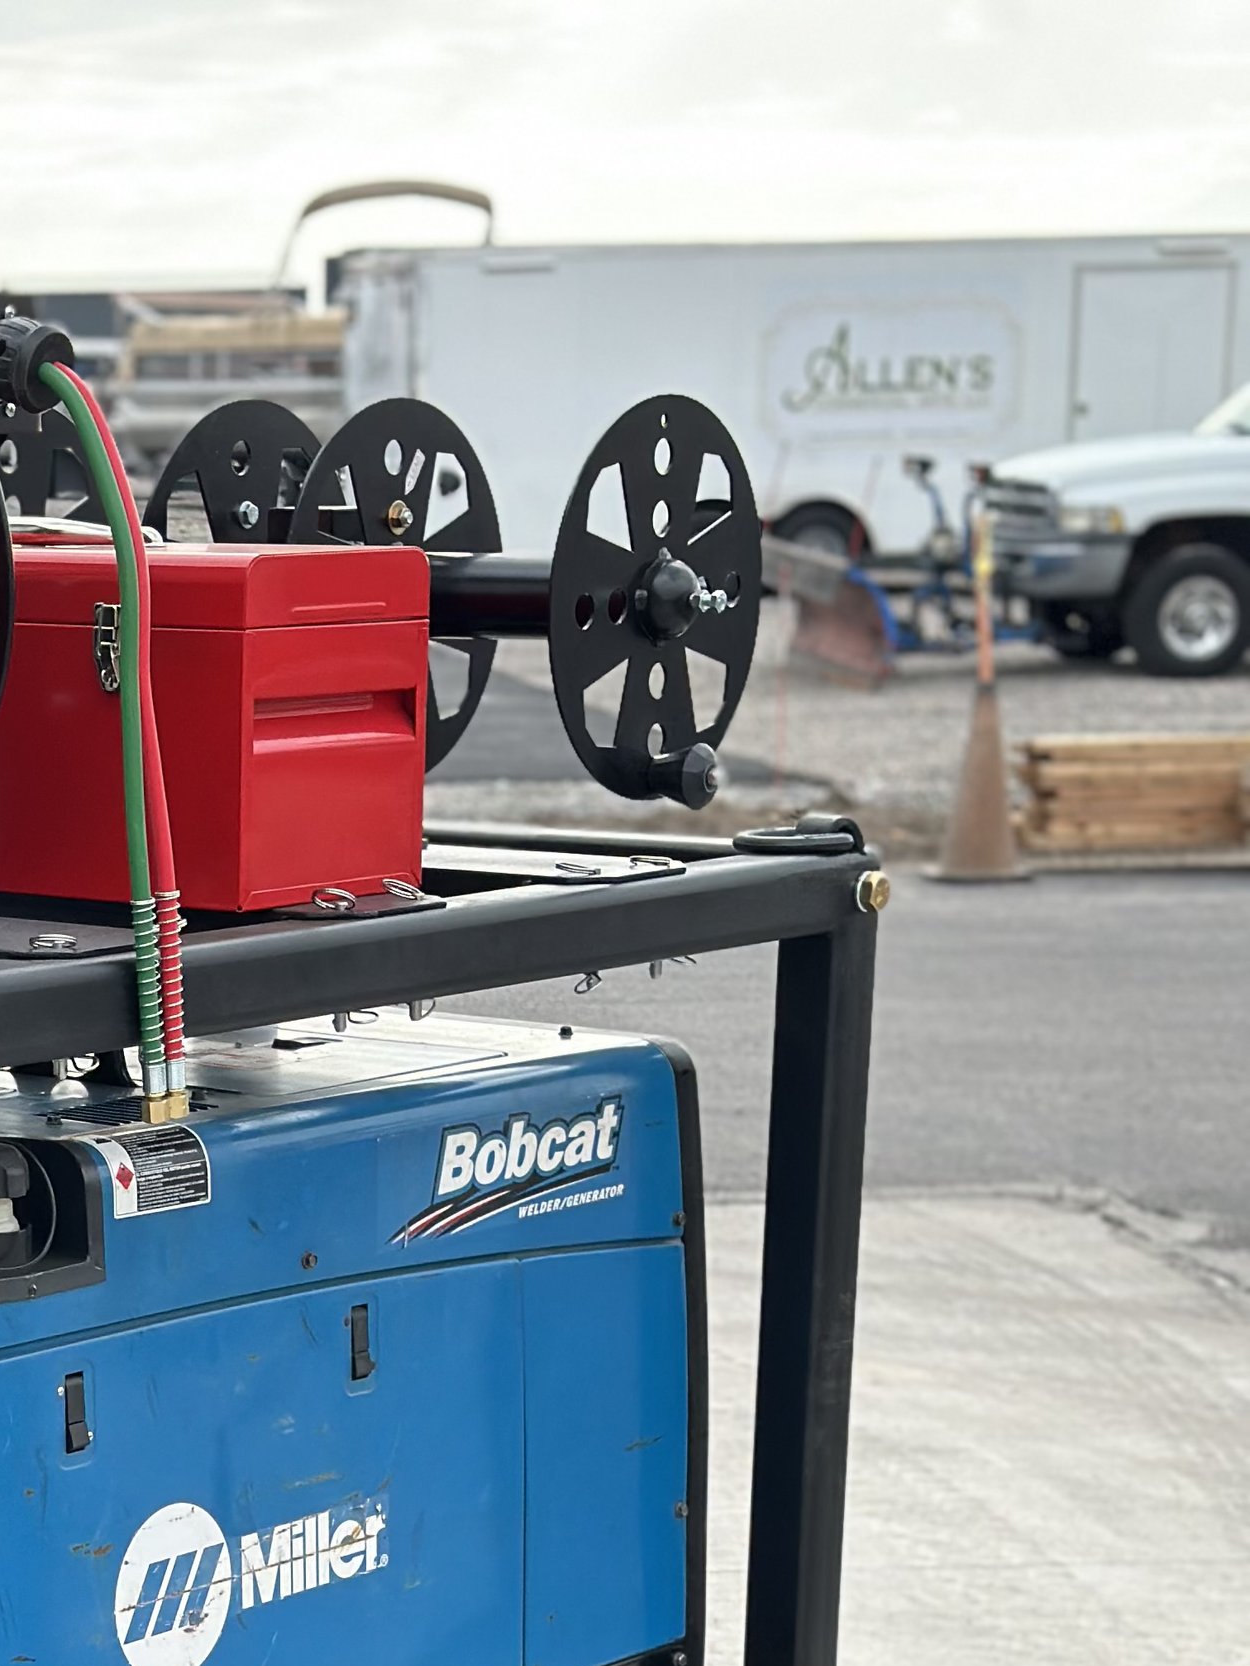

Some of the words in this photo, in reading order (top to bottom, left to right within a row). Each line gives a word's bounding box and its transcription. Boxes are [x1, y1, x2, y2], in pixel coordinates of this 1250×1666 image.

[780, 322, 995, 412] ALLEN'S
[436, 1103, 619, 1197] Bobcat
[517, 1184, 625, 1219] WELDER/GENERATOR
[240, 1510, 386, 1610] Miller
